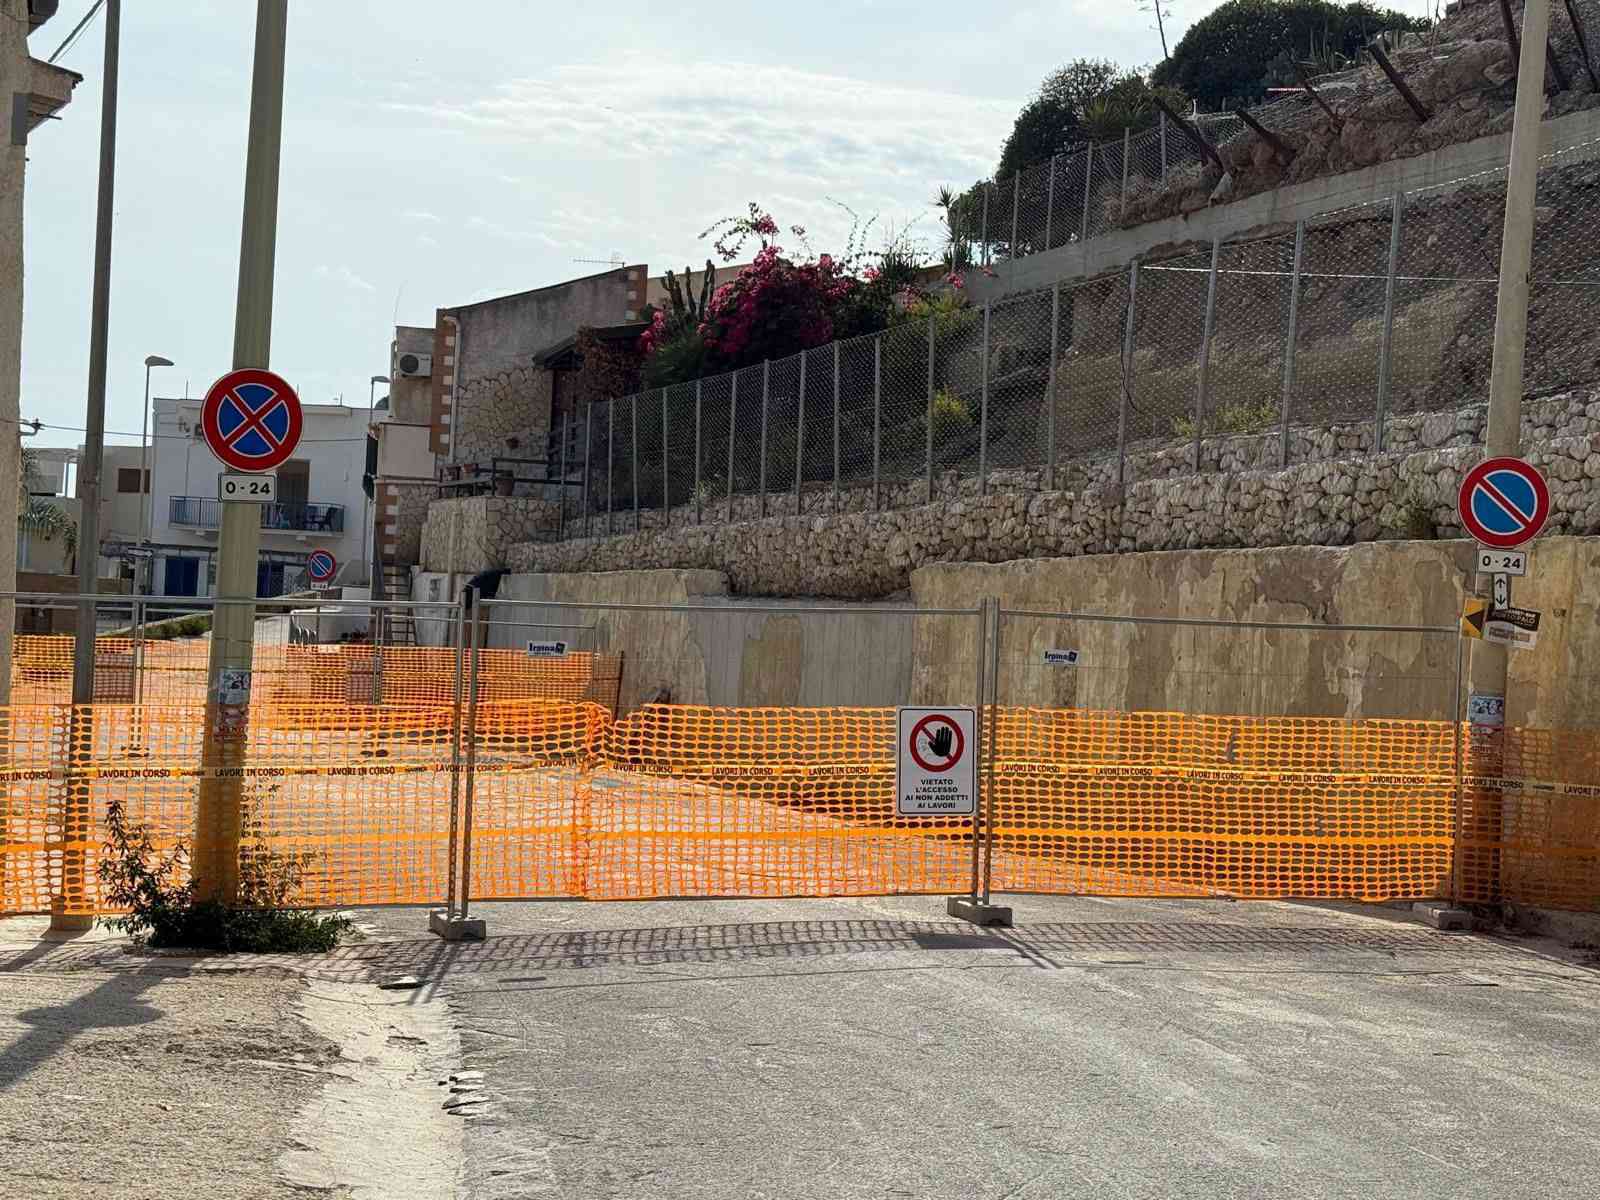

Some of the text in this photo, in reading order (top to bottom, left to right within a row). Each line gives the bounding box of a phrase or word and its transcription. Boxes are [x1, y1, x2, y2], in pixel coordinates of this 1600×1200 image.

[225, 481, 236, 494] 0
[249, 482, 271, 495] 24
[1482, 556, 1491, 566] 0
[1503, 557, 1521, 568] 24
[215, 768, 244, 777] LAVORI
[258, 768, 285, 777] CORSO
[328, 767, 356, 776] LAVORI
[369, 766, 395, 775] CORSO
[436, 765, 463, 773] LAVORI
[712, 767, 738, 775] LAVORI
[749, 767, 774, 775] CORSO
[809, 767, 835, 776] LAVORI
[846, 766, 869, 774] CORSO
[1002, 764, 1026, 772] LAVORI
[1037, 765, 1060, 773] CORSO
[1096, 767, 1120, 775] LAVORI
[1131, 768, 1152, 776] CORSO
[24, 770, 52, 780] CORSO
[98, 770, 129, 778] LAVORI
[143, 769, 170, 778] CORSO
[1221, 772, 1244, 781] CORSO
[1314, 774, 1337, 783] CORSO
[1402, 776, 1425, 785] CORSO
[1499, 780, 1524, 789] CORSO
